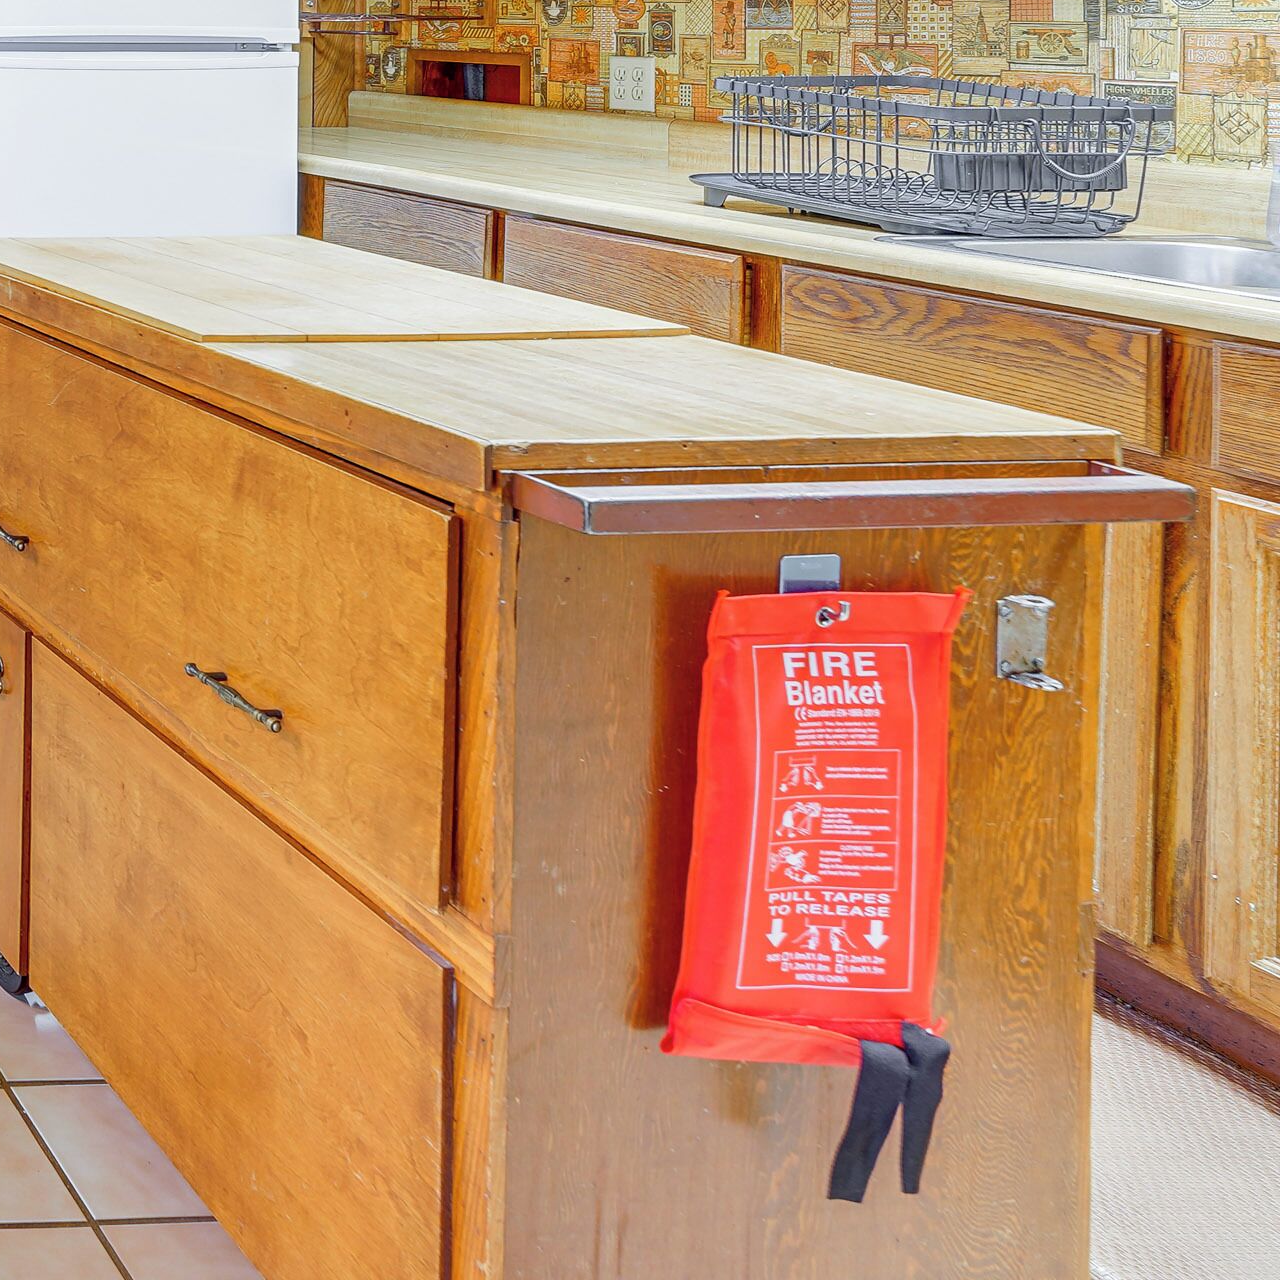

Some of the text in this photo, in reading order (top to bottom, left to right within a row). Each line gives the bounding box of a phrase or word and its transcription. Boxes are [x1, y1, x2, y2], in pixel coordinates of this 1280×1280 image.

[1187, 34, 1225, 47] FIRE
[1105, 85, 1174, 96] HIGH-WHEELER
[782, 651, 879, 678] FIRE
[784, 679, 886, 706] Blanket
[768, 891, 891, 904] PULL TAPES
[768, 903, 891, 918] TO RELEASE
